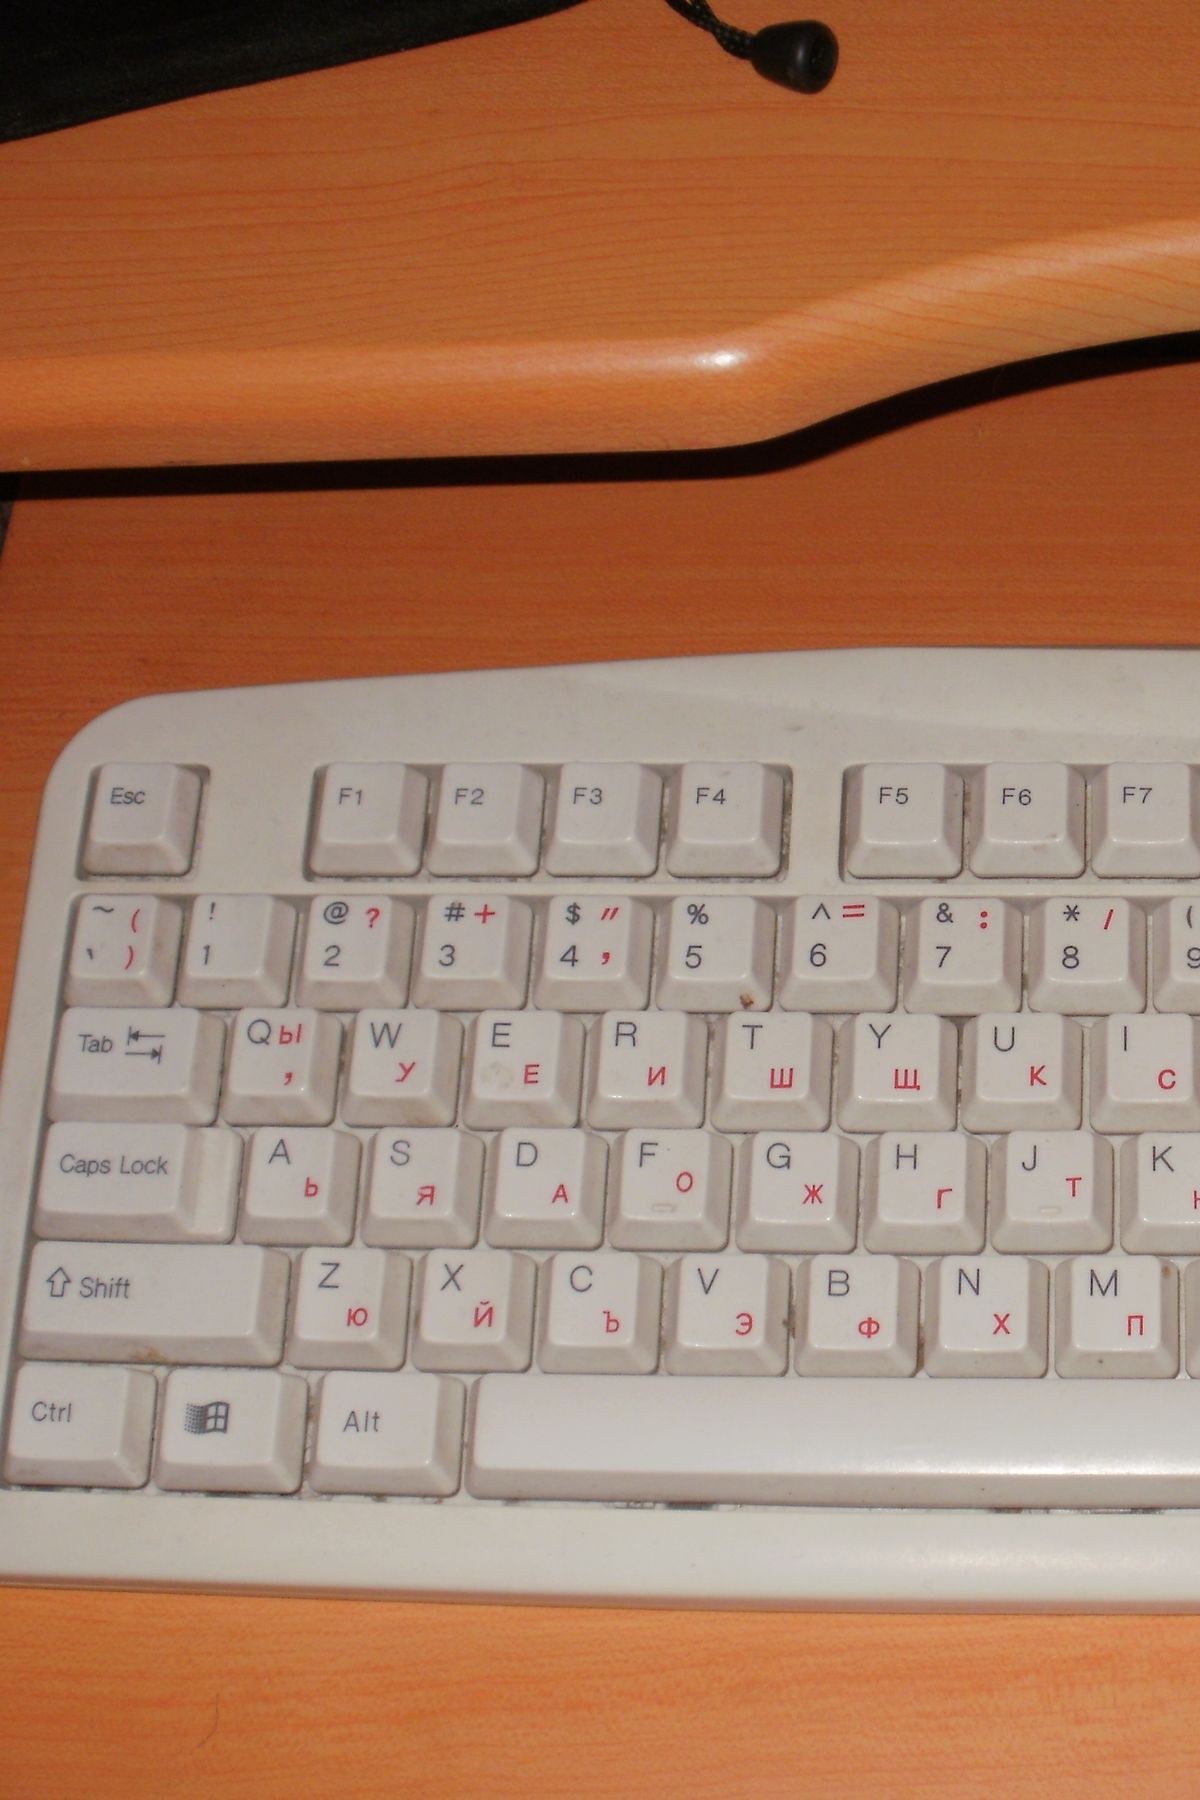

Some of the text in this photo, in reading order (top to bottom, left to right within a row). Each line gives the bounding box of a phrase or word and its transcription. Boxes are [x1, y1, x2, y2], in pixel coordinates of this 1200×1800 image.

[110, 786, 147, 806] Esc
[338, 786, 363, 806] F1
[454, 787, 485, 806] F2
[572, 786, 604, 806] F3
[695, 786, 727, 806] F4
[878, 786, 910, 806] F5
[1001, 786, 1033, 807] F6
[1122, 785, 1154, 805] F7
[208, 901, 217, 921] !
[322, 900, 350, 926] @
[365, 906, 381, 930] ?
[444, 901, 467, 923] #
[473, 903, 497, 925] +
[564, 901, 582, 926] $
[686, 902, 710, 926] %
[935, 901, 955, 924] &
[203, 944, 212, 966] 1
[323, 944, 342, 968] 2
[438, 943, 457, 968] 3
[559, 943, 580, 968] 4
[684, 944, 703, 970] 5
[808, 942, 828, 968] 6
[935, 944, 953, 969] 7
[1061, 944, 1081, 970] 8
[78, 1033, 114, 1054] Tab
[246, 1018, 273, 1046] Q
[370, 1021, 403, 1049] W
[491, 1021, 513, 1049] E
[614, 1020, 638, 1048] R
[741, 1023, 764, 1051] T
[868, 1023, 893, 1050] Y
[993, 1025, 1016, 1053] U
[59, 1152, 169, 1178] Caps Lock
[267, 1138, 292, 1166] A
[389, 1138, 411, 1167] S
[515, 1141, 539, 1168] D
[638, 1141, 660, 1169] F
[765, 1141, 792, 1171] G
[895, 1143, 919, 1171] H
[1020, 1144, 1038, 1172] J
[1151, 1145, 1175, 1173] K
[78, 1276, 132, 1300] Shift
[317, 1261, 341, 1290] Z
[440, 1263, 465, 1292] X
[569, 1264, 594, 1294] C
[696, 1267, 720, 1296] V
[827, 1269, 851, 1298] B
[957, 1267, 981, 1297] N
[1089, 1268, 1119, 1298] M
[31, 1400, 73, 1423] Ctrl
[342, 1409, 381, 1433] Alt
